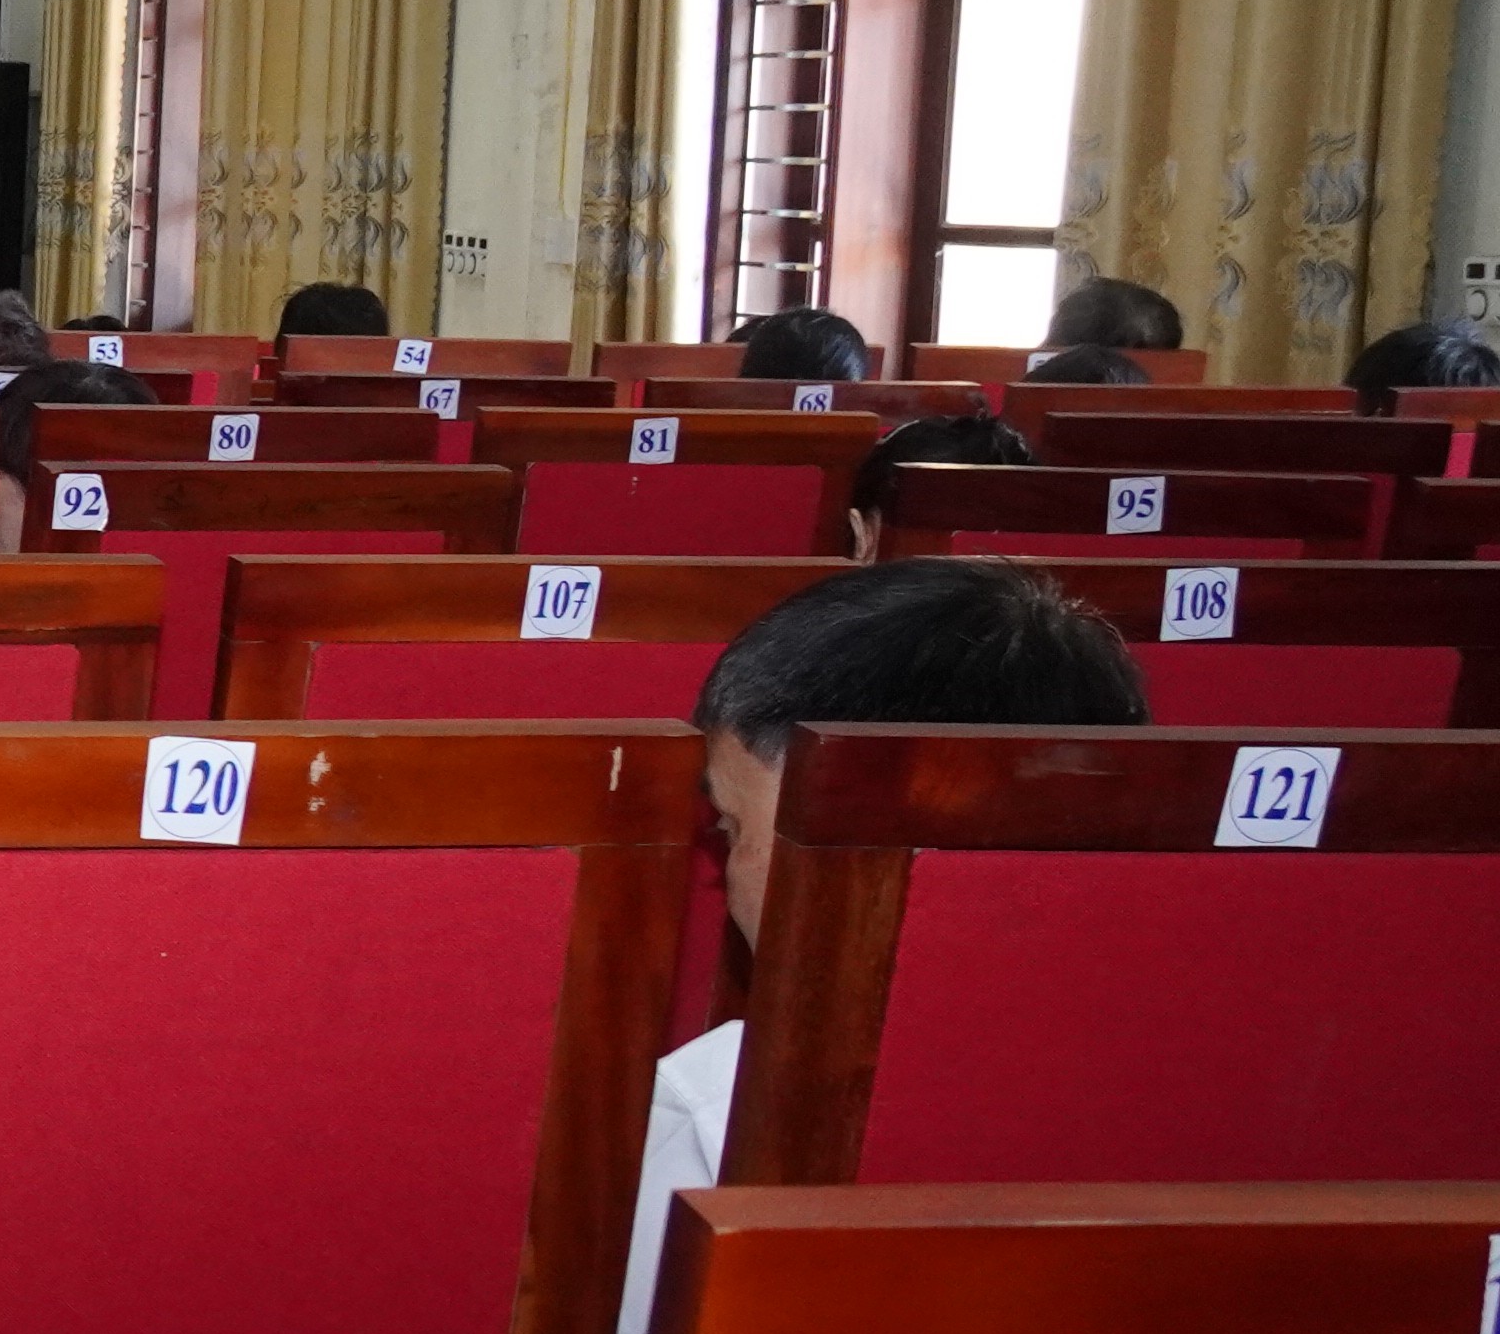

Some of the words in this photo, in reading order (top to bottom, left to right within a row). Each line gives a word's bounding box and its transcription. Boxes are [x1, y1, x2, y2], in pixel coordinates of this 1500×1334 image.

[95, 340, 120, 360] 53
[401, 346, 427, 367] 54
[424, 387, 455, 409] 67
[799, 393, 828, 412] 68
[217, 423, 252, 450] 80
[638, 428, 669, 454] 81
[62, 486, 102, 517] 92
[1117, 488, 1158, 520] 95
[533, 580, 592, 620] 107
[1173, 580, 1228, 622] 108
[158, 759, 239, 816] 120
[1238, 766, 1317, 822] 121
